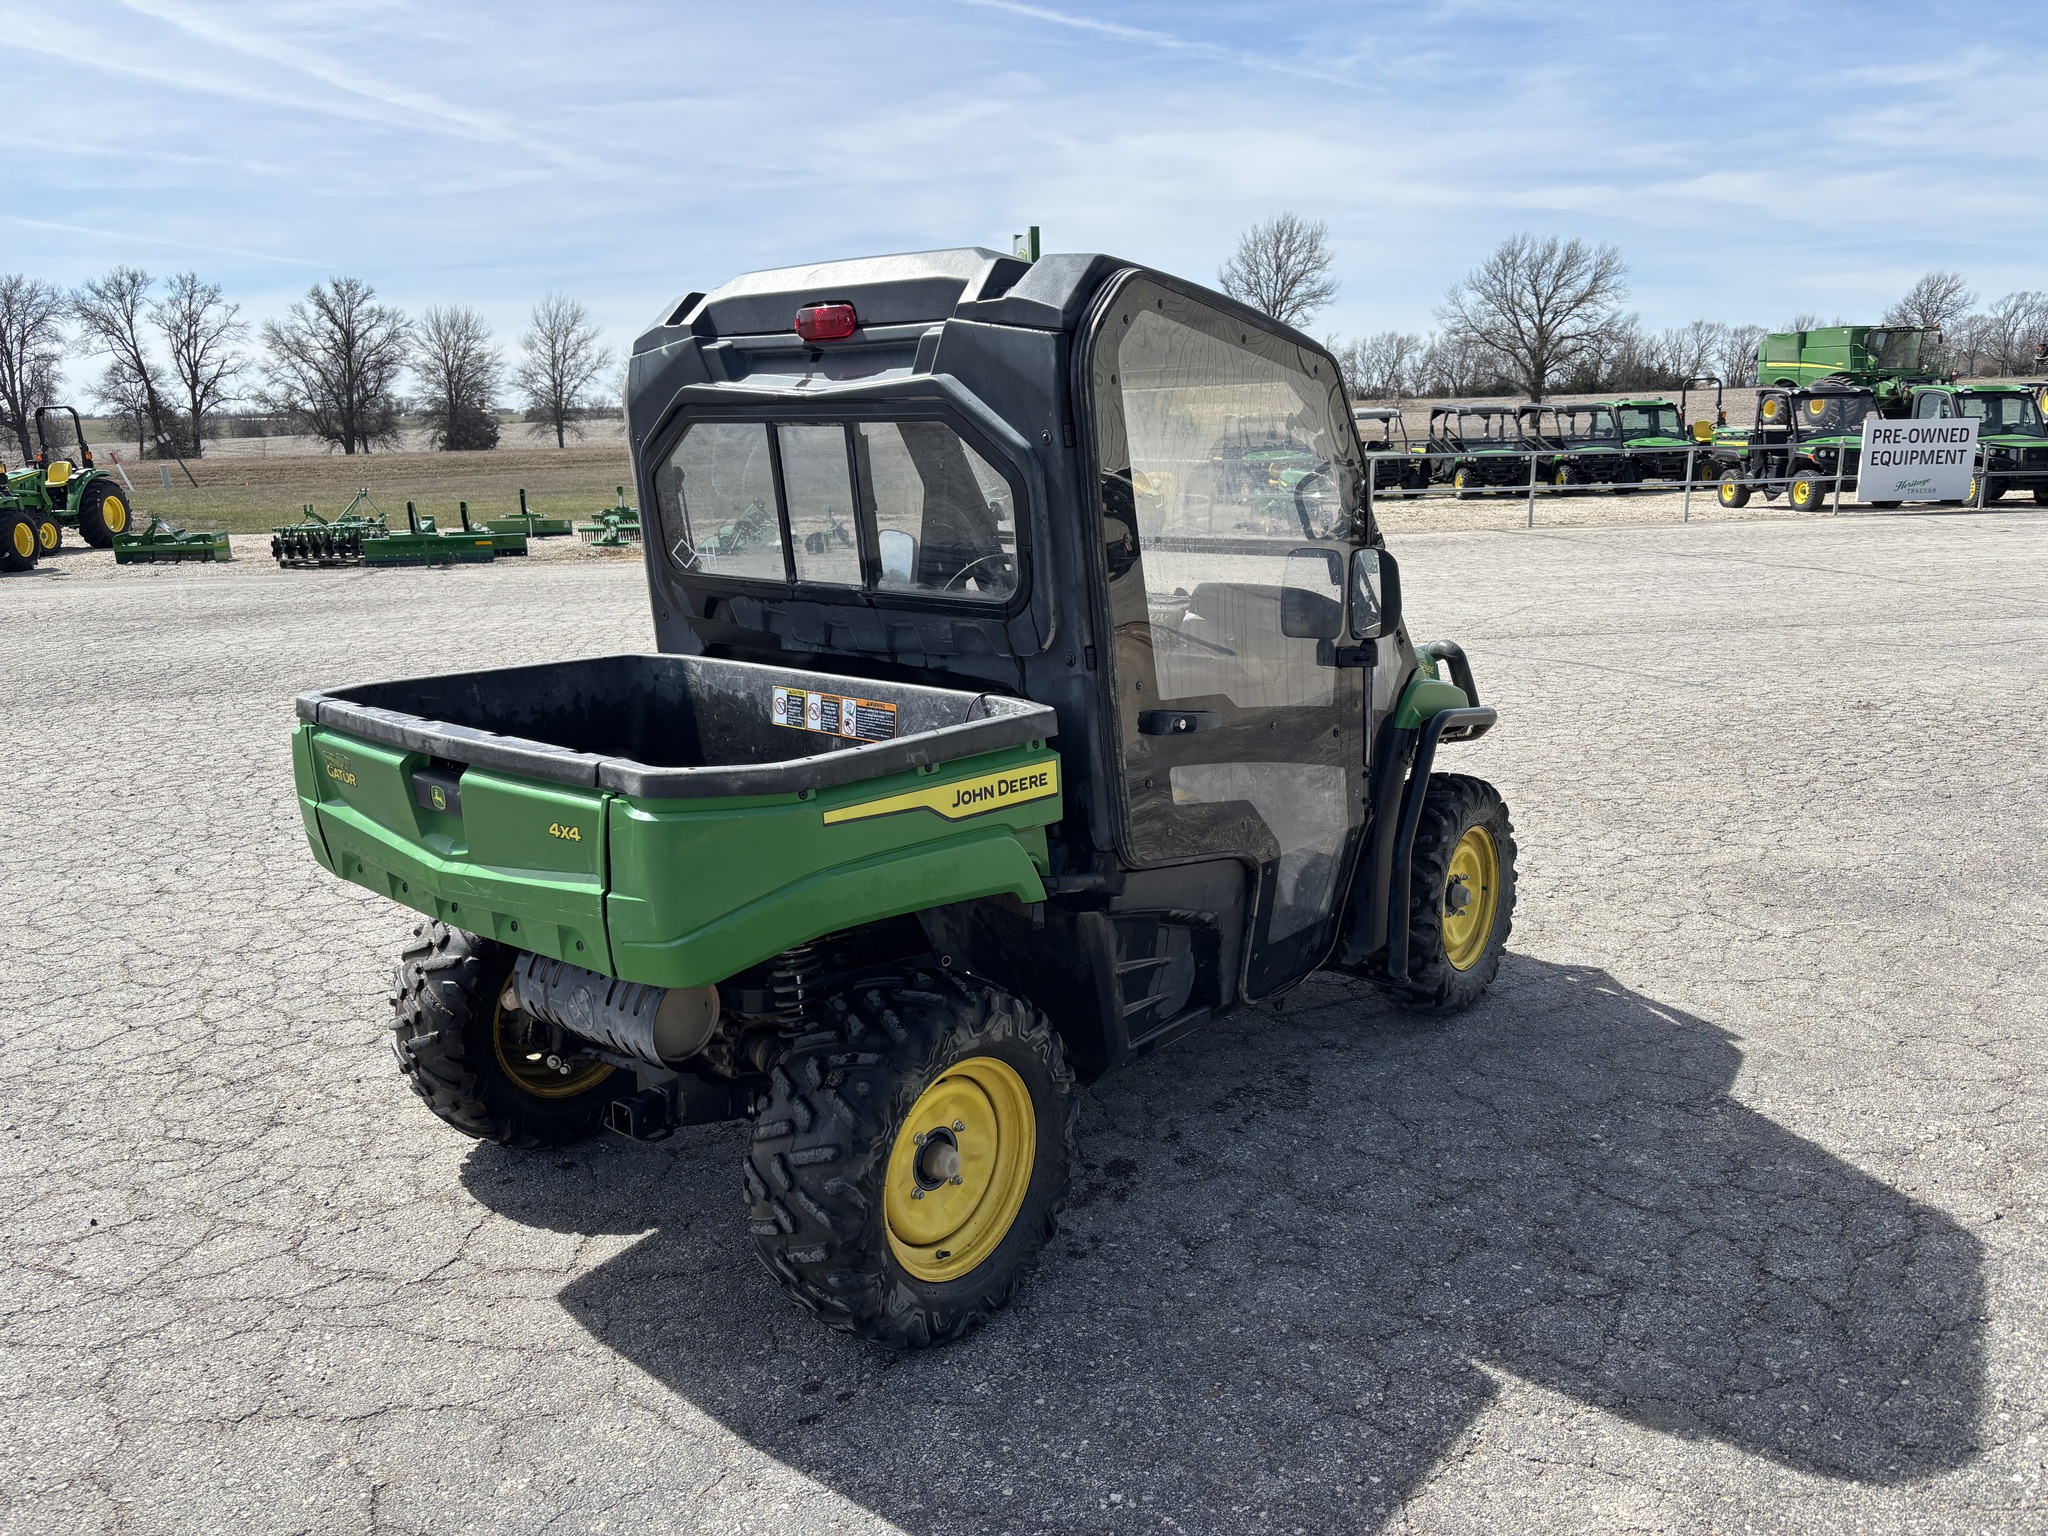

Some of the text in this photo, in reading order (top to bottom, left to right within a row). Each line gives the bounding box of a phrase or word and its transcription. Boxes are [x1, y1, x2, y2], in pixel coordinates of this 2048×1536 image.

[1872, 428, 1970, 444] PRE-OWNED
[1870, 449, 1967, 467] EQUIPMENT
[1893, 478, 1932, 492] Heritage
[326, 764, 357, 787] GATOR
[952, 772, 1048, 809] JOHN DEERE
